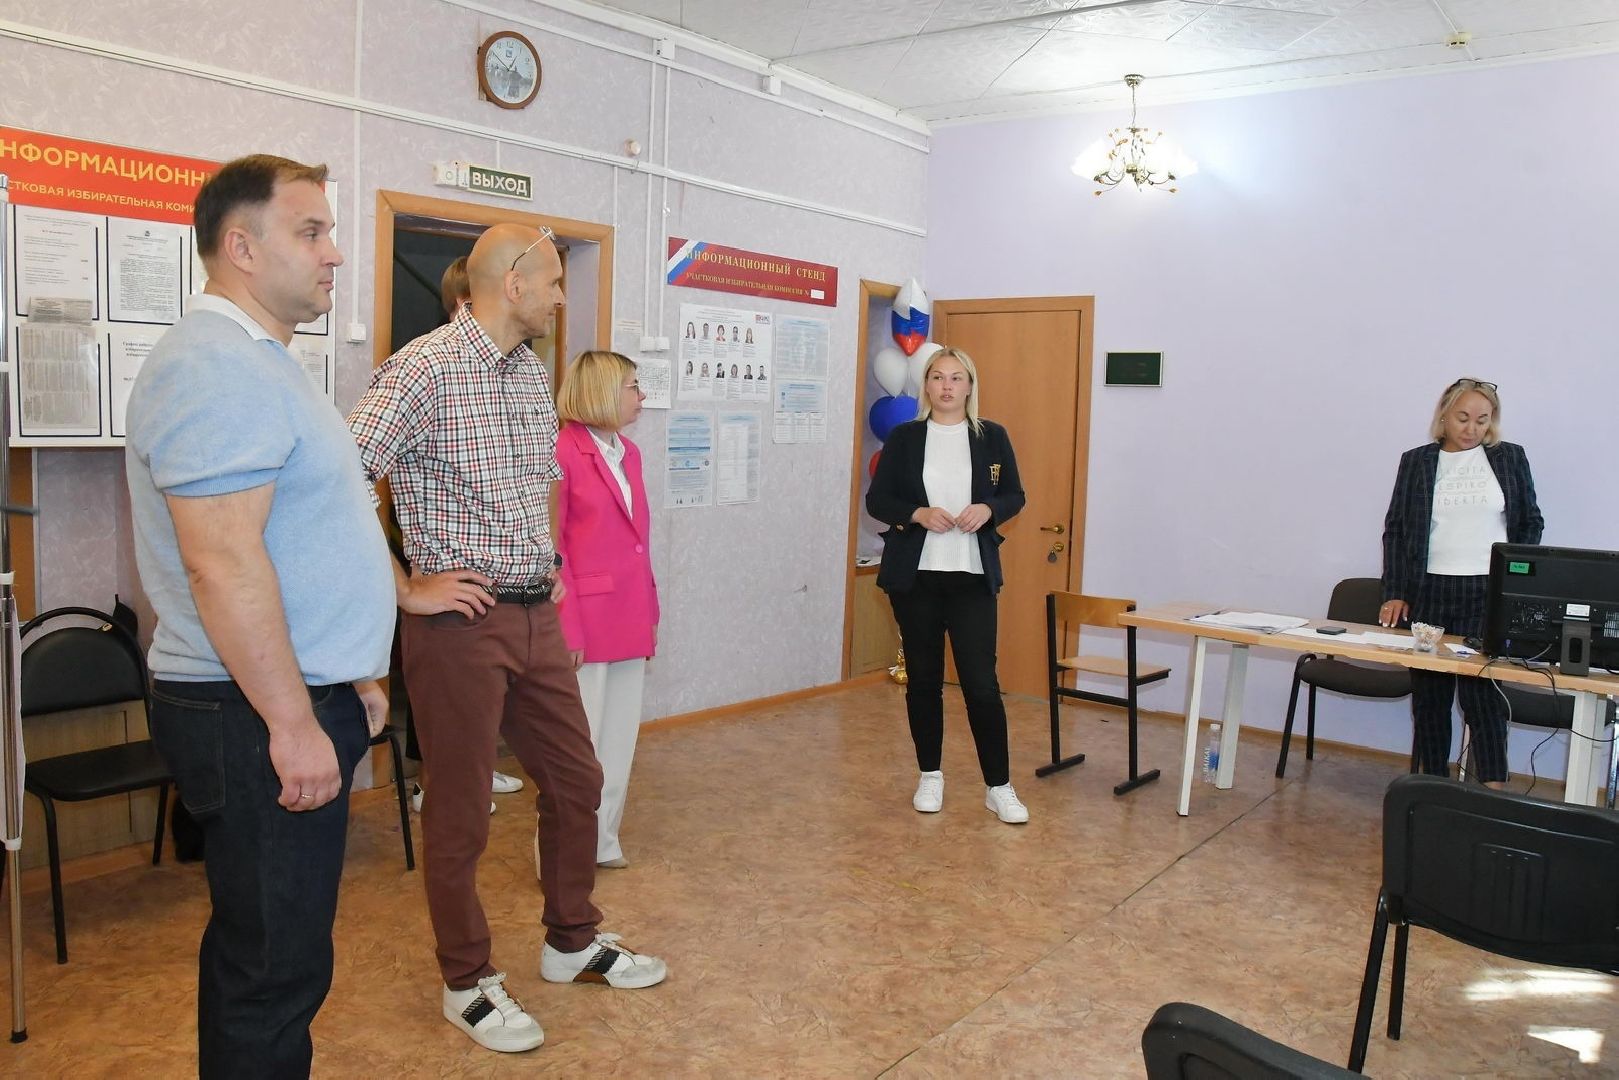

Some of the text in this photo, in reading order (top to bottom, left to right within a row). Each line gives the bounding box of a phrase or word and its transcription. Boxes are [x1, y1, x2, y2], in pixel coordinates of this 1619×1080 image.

[0, 139, 210, 187] НФОРМАЦИОНН
[8, 180, 64, 197] СТКОВАЯ
[67, 188, 163, 209] ИЗБИРАТЕЛЬНАЯ
[472, 171, 528, 196] ВЫХОД
[685, 272, 725, 285] УЧАСТКОВАЯ
[686, 249, 826, 283] ИНФОРМАЦИОННЫЙ СТЕНД
